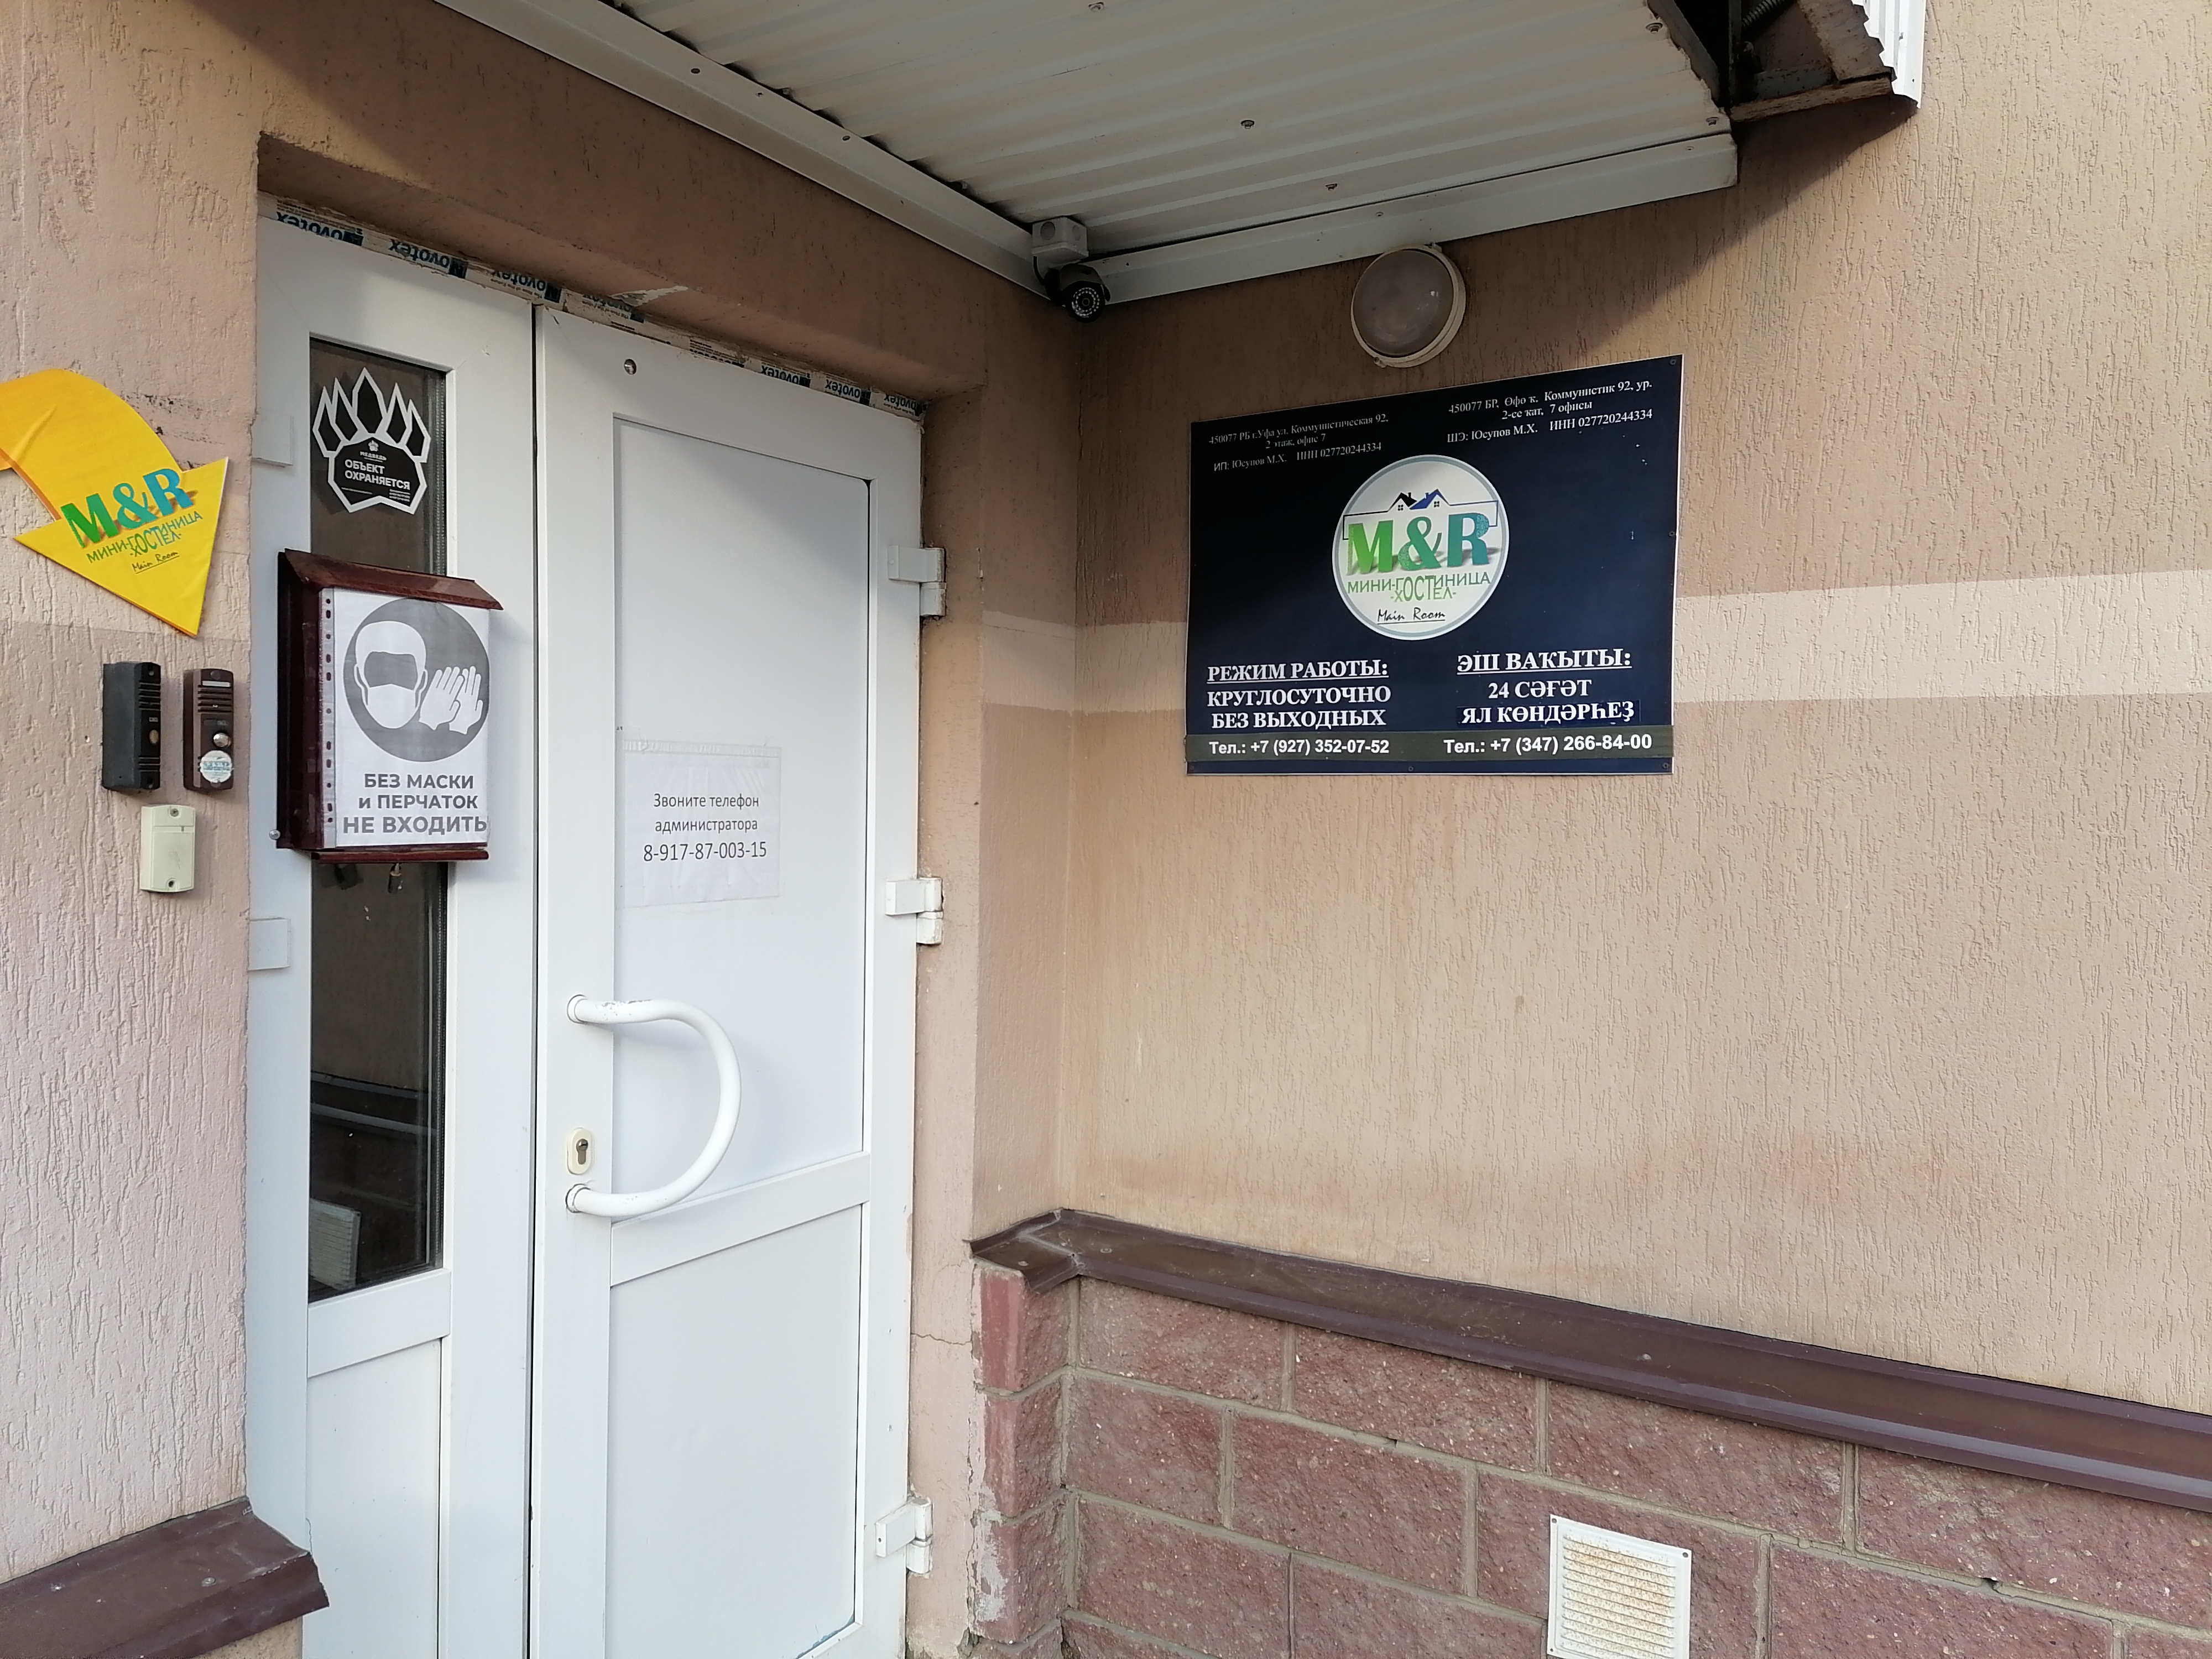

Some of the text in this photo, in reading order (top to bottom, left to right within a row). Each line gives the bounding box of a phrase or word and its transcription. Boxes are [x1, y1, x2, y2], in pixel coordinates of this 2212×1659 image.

[1448, 401, 1482, 414] 450077
[1544, 385, 1615, 403] Коммунистик
[1618, 380, 1634, 393] 92,
[1636, 380, 1652, 392] ур.
[1550, 404, 1556, 414] 7
[1558, 400, 1593, 414] офисы
[1209, 433, 1237, 445] 450077
[1239, 431, 1251, 441] РБ
[1276, 427, 1289, 439] ул.
[1291, 417, 1373, 435] Коммунистическая
[1375, 414, 1389, 424] 92,
[1447, 409, 1653, 443] ШЭ: Юсупов М.Х. ИНН 027720244334
[1265, 440, 1271, 448] 2
[1297, 435, 1318, 447] офис
[1321, 434, 1326, 442] 7
[345, 459, 385, 474] ОБЪЕКТ
[1214, 442, 1382, 472] ИП: Юсупов М.Х. ИНН 027720244334
[345, 470, 410, 491] ОХРАНЯЕТСЯ
[60, 468, 194, 549] M&R
[1346, 512, 1490, 576] M&R
[132, 551, 179, 572] Main Room
[1377, 607, 1446, 622] Main Room
[1207, 659, 1388, 682] РЕЖИМ РАБОТЫ:
[1457, 648, 1632, 672] ЭШ ВАҠЫТЫ:
[1207, 685, 1391, 707] КРУГЛОСУТОЧНО
[1488, 679, 1592, 698] 24 СӘҒӘТ
[1212, 709, 1386, 730] БЕЗ ВЫХОДНЫХ
[1460, 708, 1492, 723] ЯЛ
[1209, 739, 1390, 756] Тел.: +7 (927) 352-07-52
[1443, 734, 1652, 755] Тел.: +7 (347) 266-84-00
[364, 773, 474, 790] БЕЗ МАСКИ
[359, 795, 478, 809] и ПЕРЧАТОК
[653, 793, 759, 810] Звоните телефон
[343, 816, 487, 836] НЕ ВХОДИТЬ
[655, 819, 758, 834] администратора
[643, 841, 767, 862] 8-917-87-003-15
